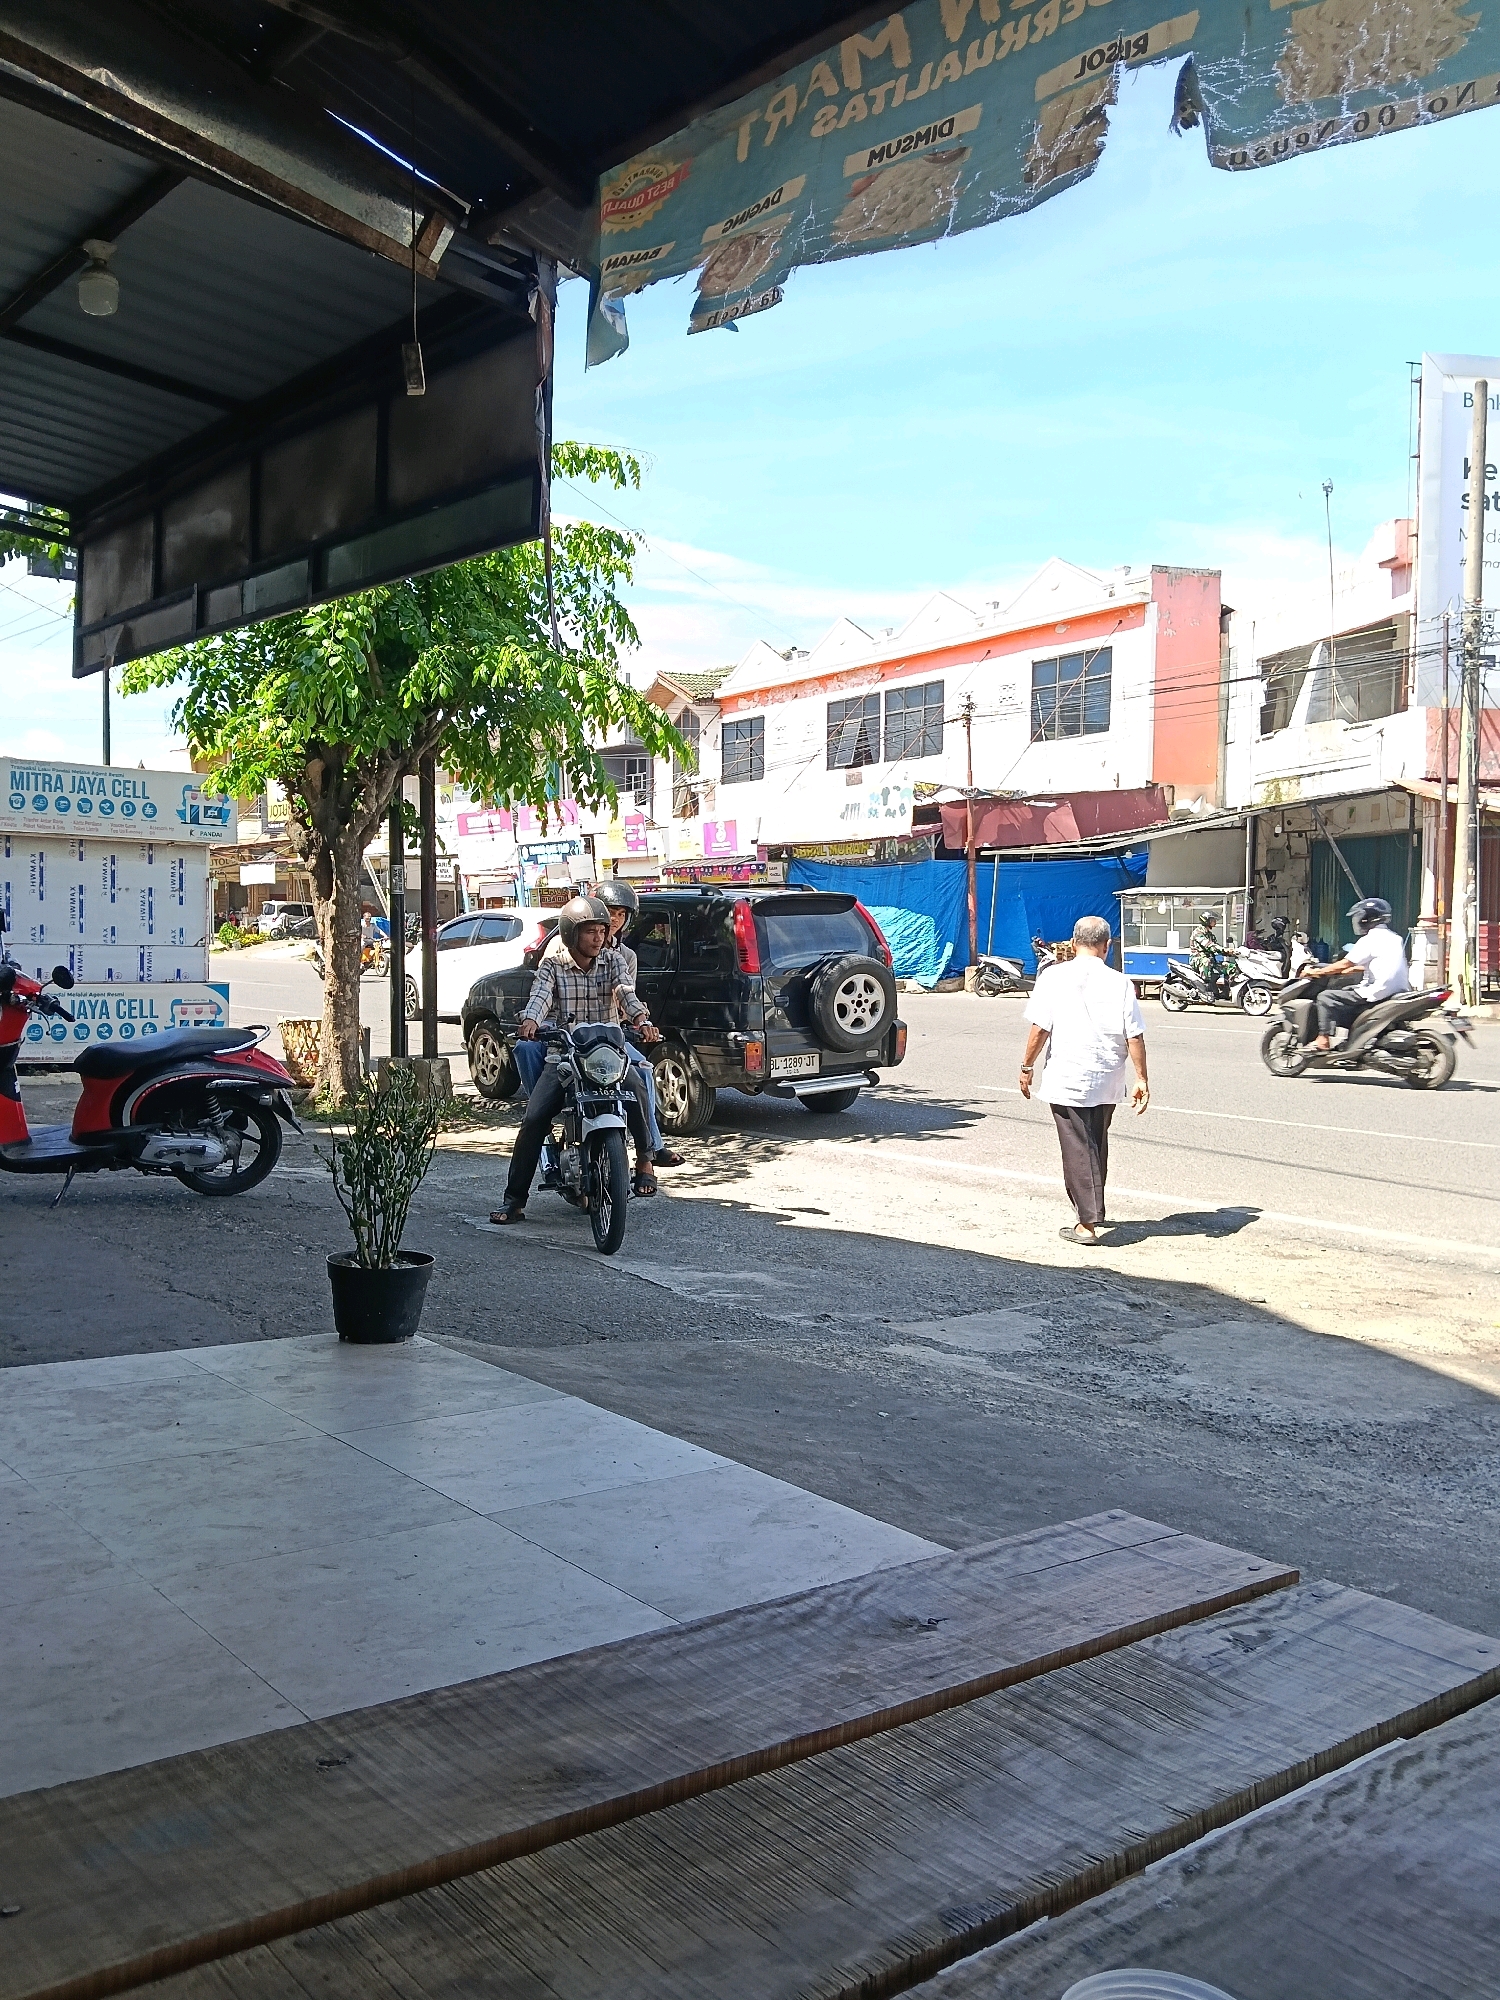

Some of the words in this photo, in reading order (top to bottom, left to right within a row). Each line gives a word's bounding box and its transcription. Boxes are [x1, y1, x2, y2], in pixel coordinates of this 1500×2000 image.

[10, 770, 64, 793] MITRA
[69, 775, 107, 796] JAYA
[111, 778, 150, 799] CELL
[199, 830, 223, 838] PANDAI
[70, 999, 110, 1020] JAYA
[115, 999, 159, 1019] CELL
[770, 1059, 780, 1071] BL
[783, 1056, 803, 1070] 1289
[805, 1055, 816, 1067] JT
